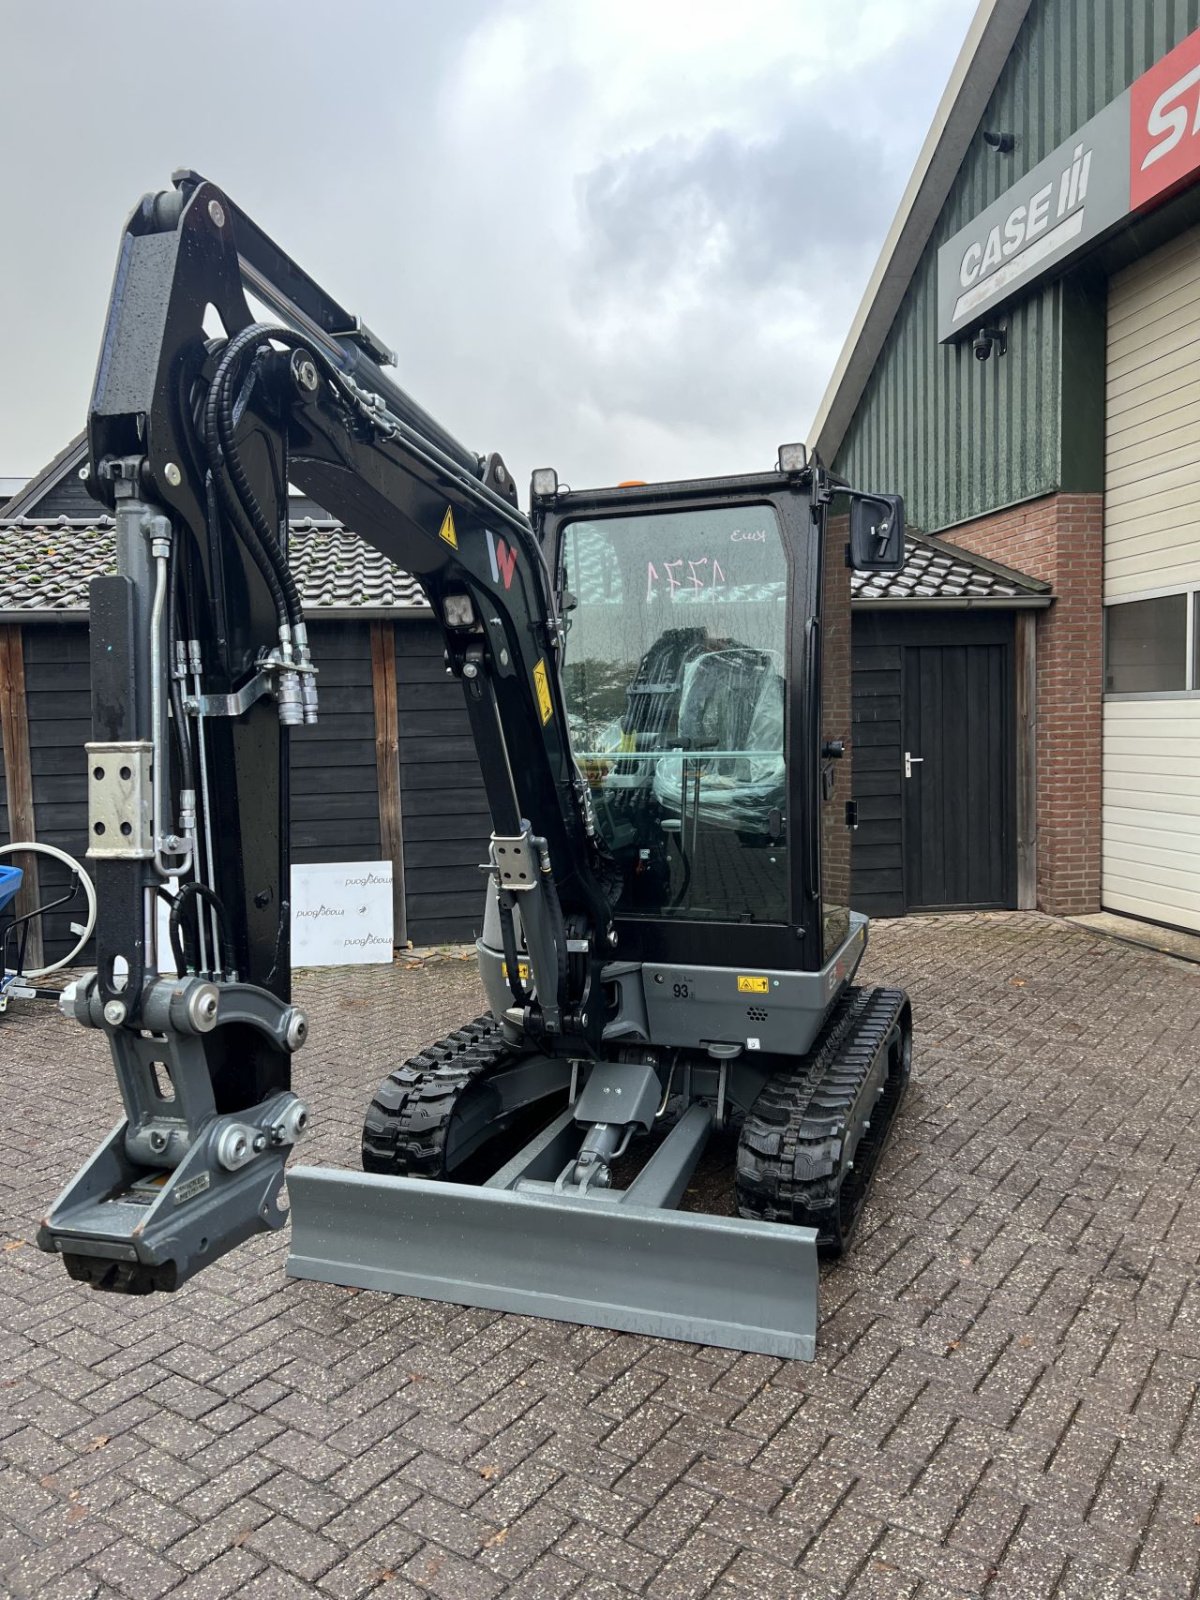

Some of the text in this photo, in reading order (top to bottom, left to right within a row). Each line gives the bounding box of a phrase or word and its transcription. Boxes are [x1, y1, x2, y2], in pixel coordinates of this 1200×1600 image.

[1140, 64, 1200, 171] S
[959, 182, 1053, 288] CASE
[673, 983, 689, 998] 93
